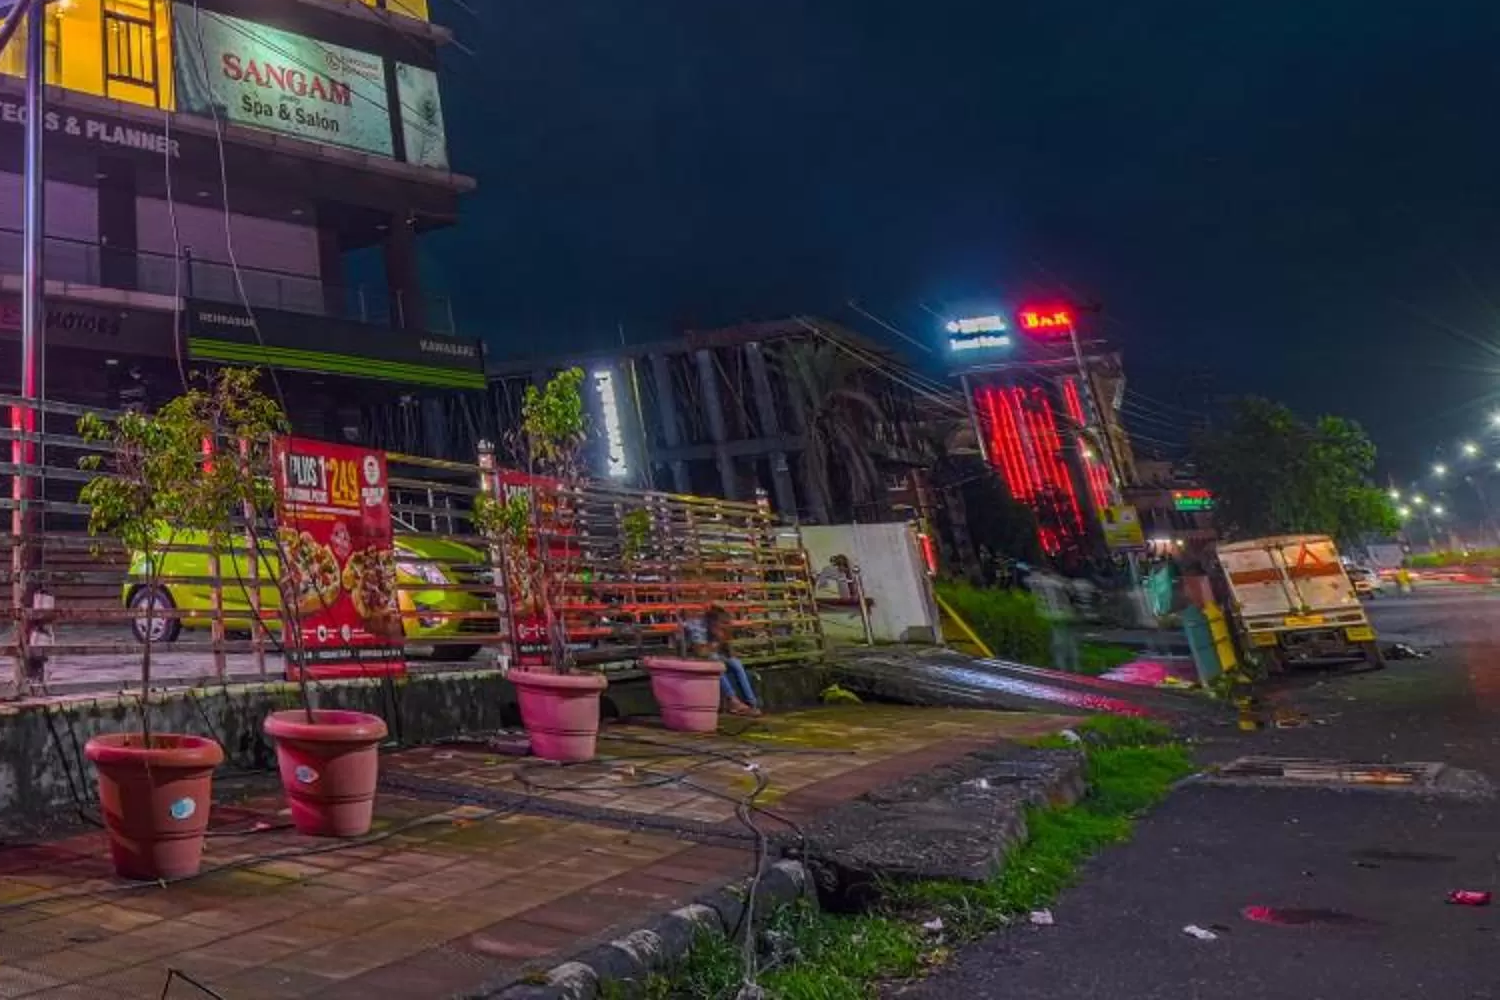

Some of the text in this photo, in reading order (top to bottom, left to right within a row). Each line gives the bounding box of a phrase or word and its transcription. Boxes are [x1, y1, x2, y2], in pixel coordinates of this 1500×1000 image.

[221, 51, 352, 108] SANGAM
[241, 93, 340, 133] Spa & Salon
[64, 113, 81, 137] &
[86, 119, 181, 158] PLANNER
[289, 455, 317, 487] PLUS
